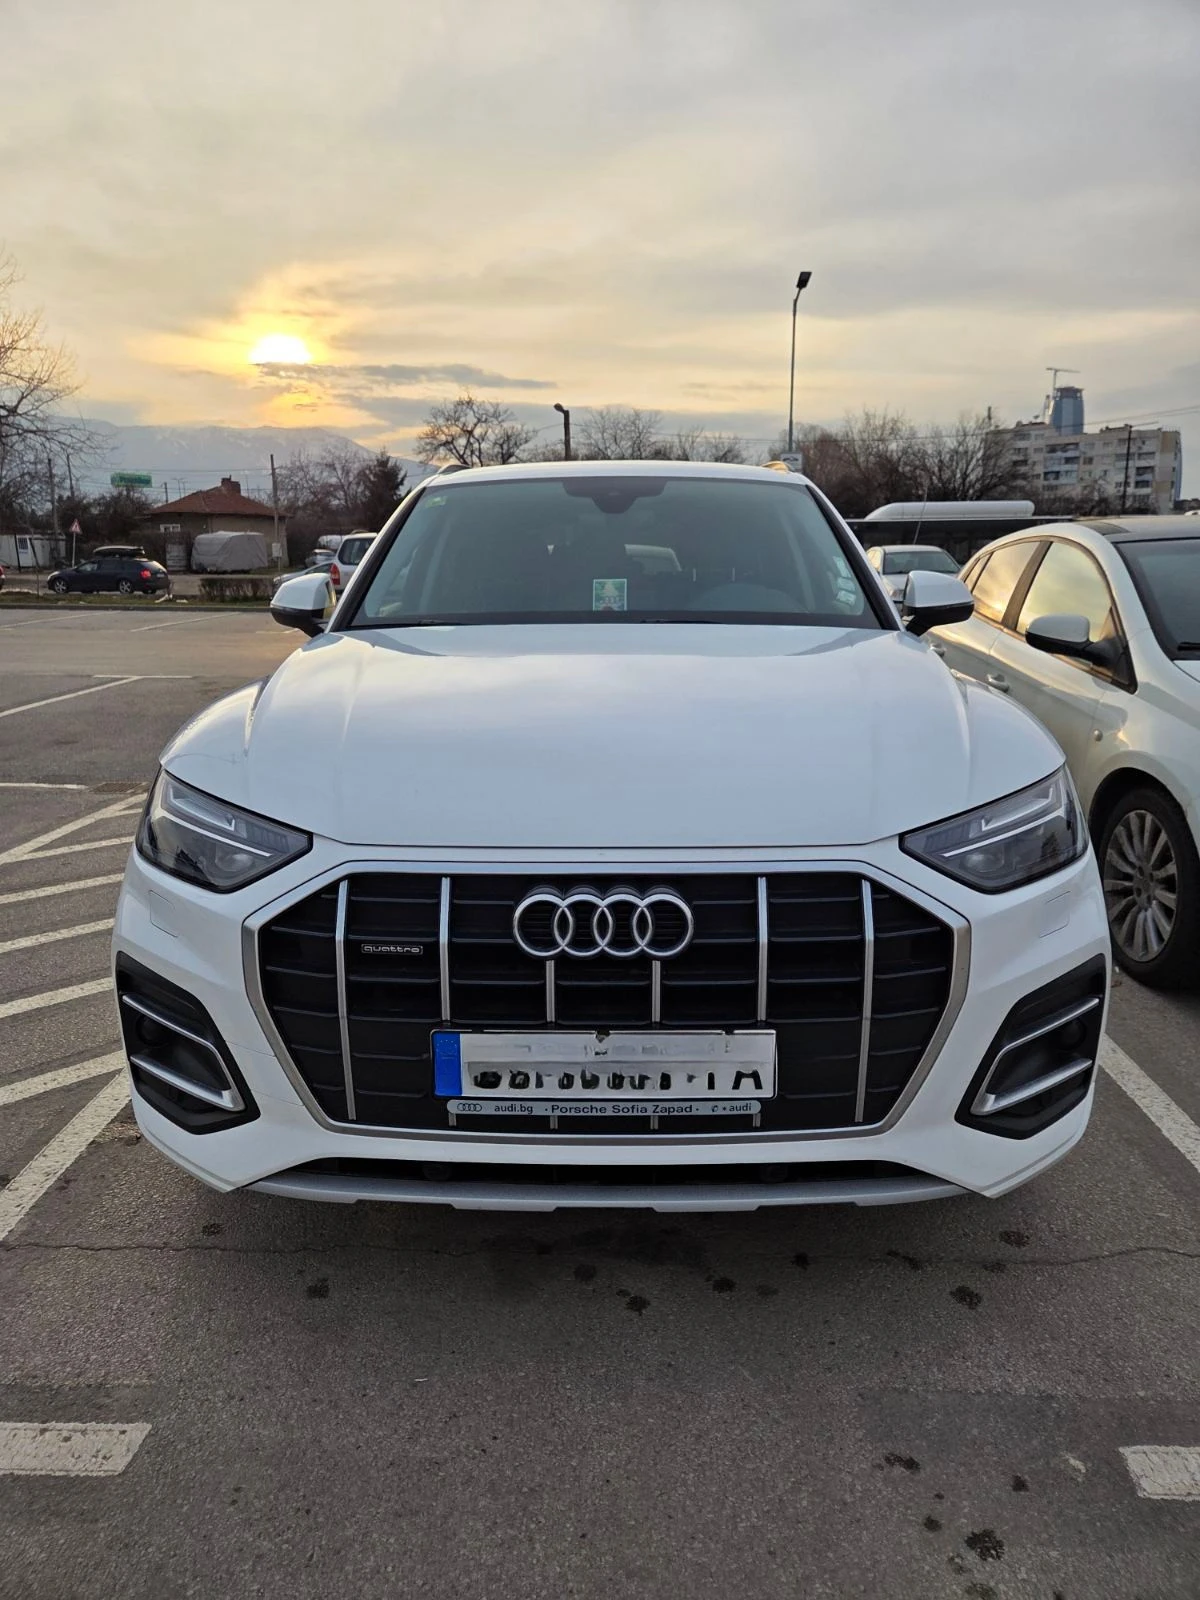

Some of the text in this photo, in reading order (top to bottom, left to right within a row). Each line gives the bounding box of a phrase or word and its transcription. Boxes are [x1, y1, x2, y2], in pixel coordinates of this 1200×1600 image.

[364, 945, 420, 953] quattro
[494, 1104, 534, 1115] audi.bg
[551, 1104, 607, 1114] Porsche
[611, 1104, 648, 1114] Sofia
[652, 1104, 693, 1115] Zapad
